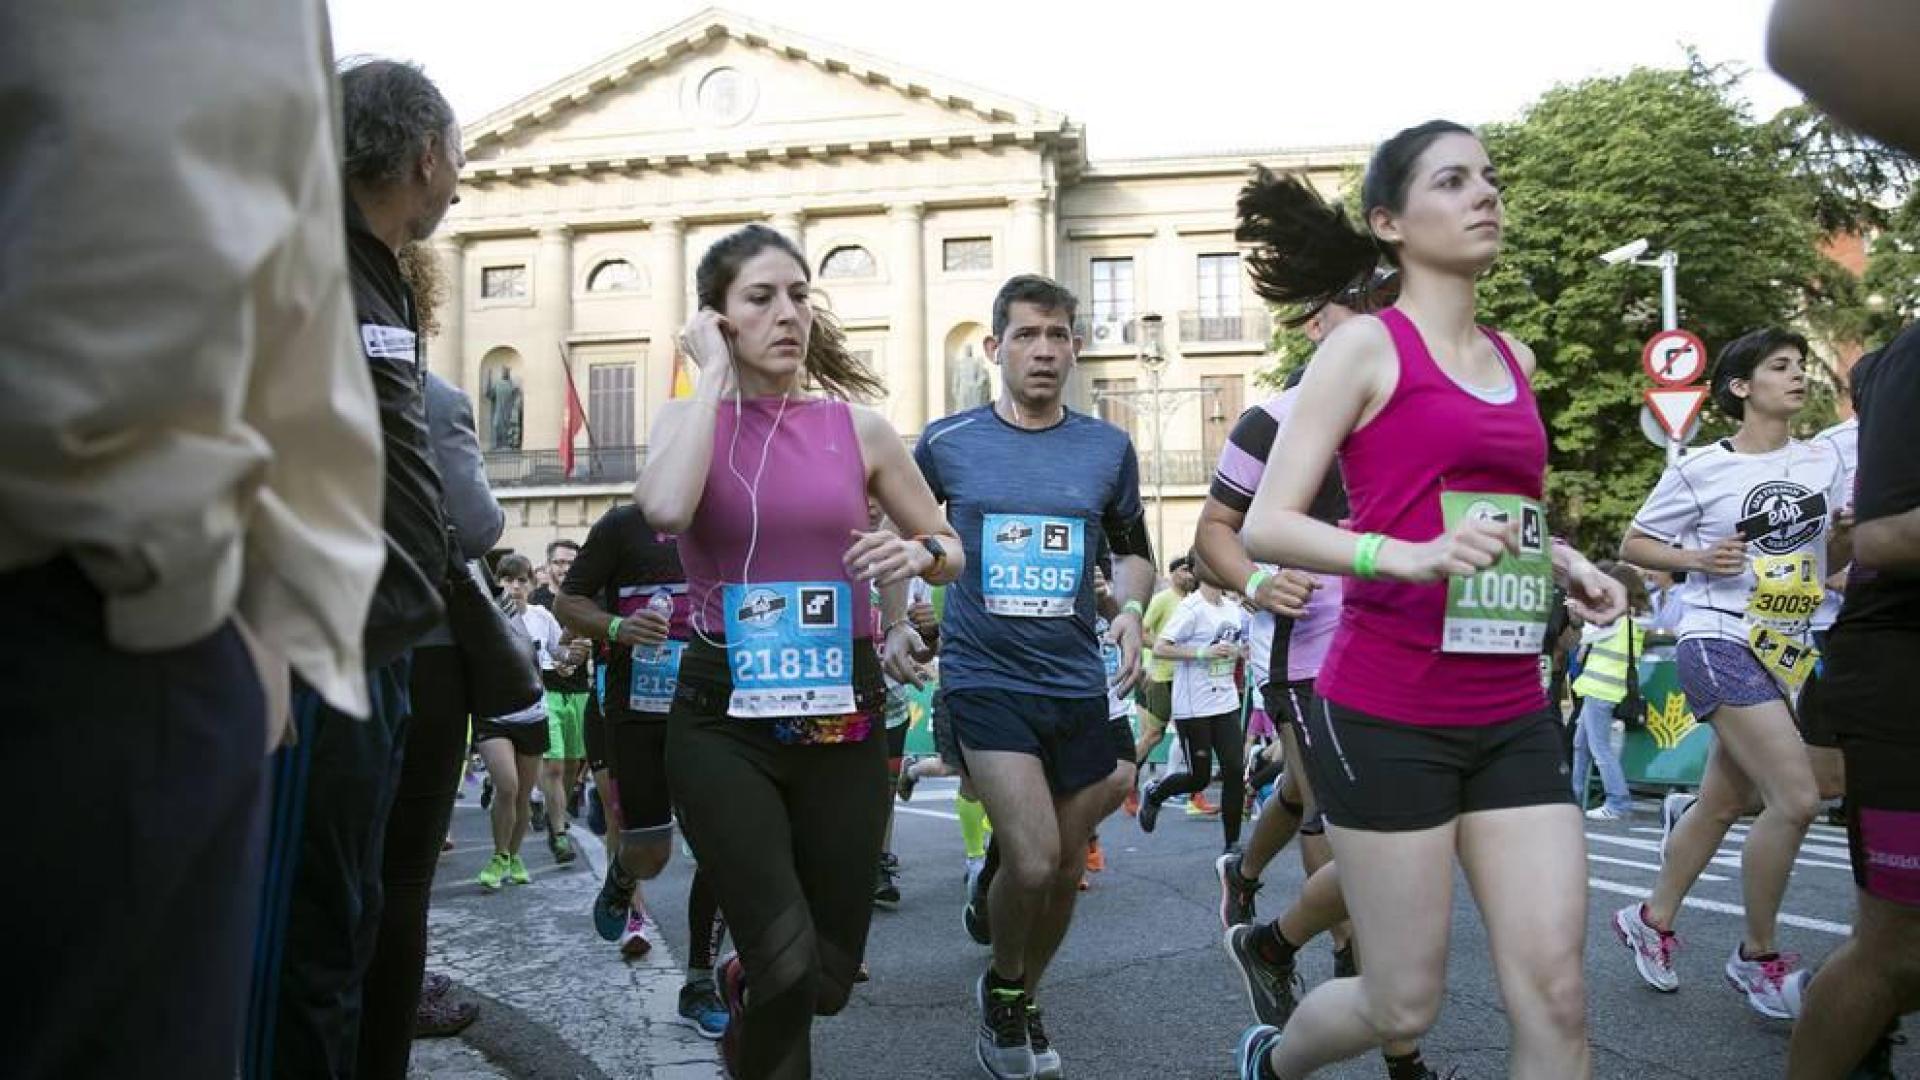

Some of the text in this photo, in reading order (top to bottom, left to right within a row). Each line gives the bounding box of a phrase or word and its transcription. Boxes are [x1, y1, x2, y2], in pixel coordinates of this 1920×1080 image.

[988, 563, 1076, 592] 21595
[1456, 571, 1547, 612] 10061
[735, 646, 843, 681] 21818
